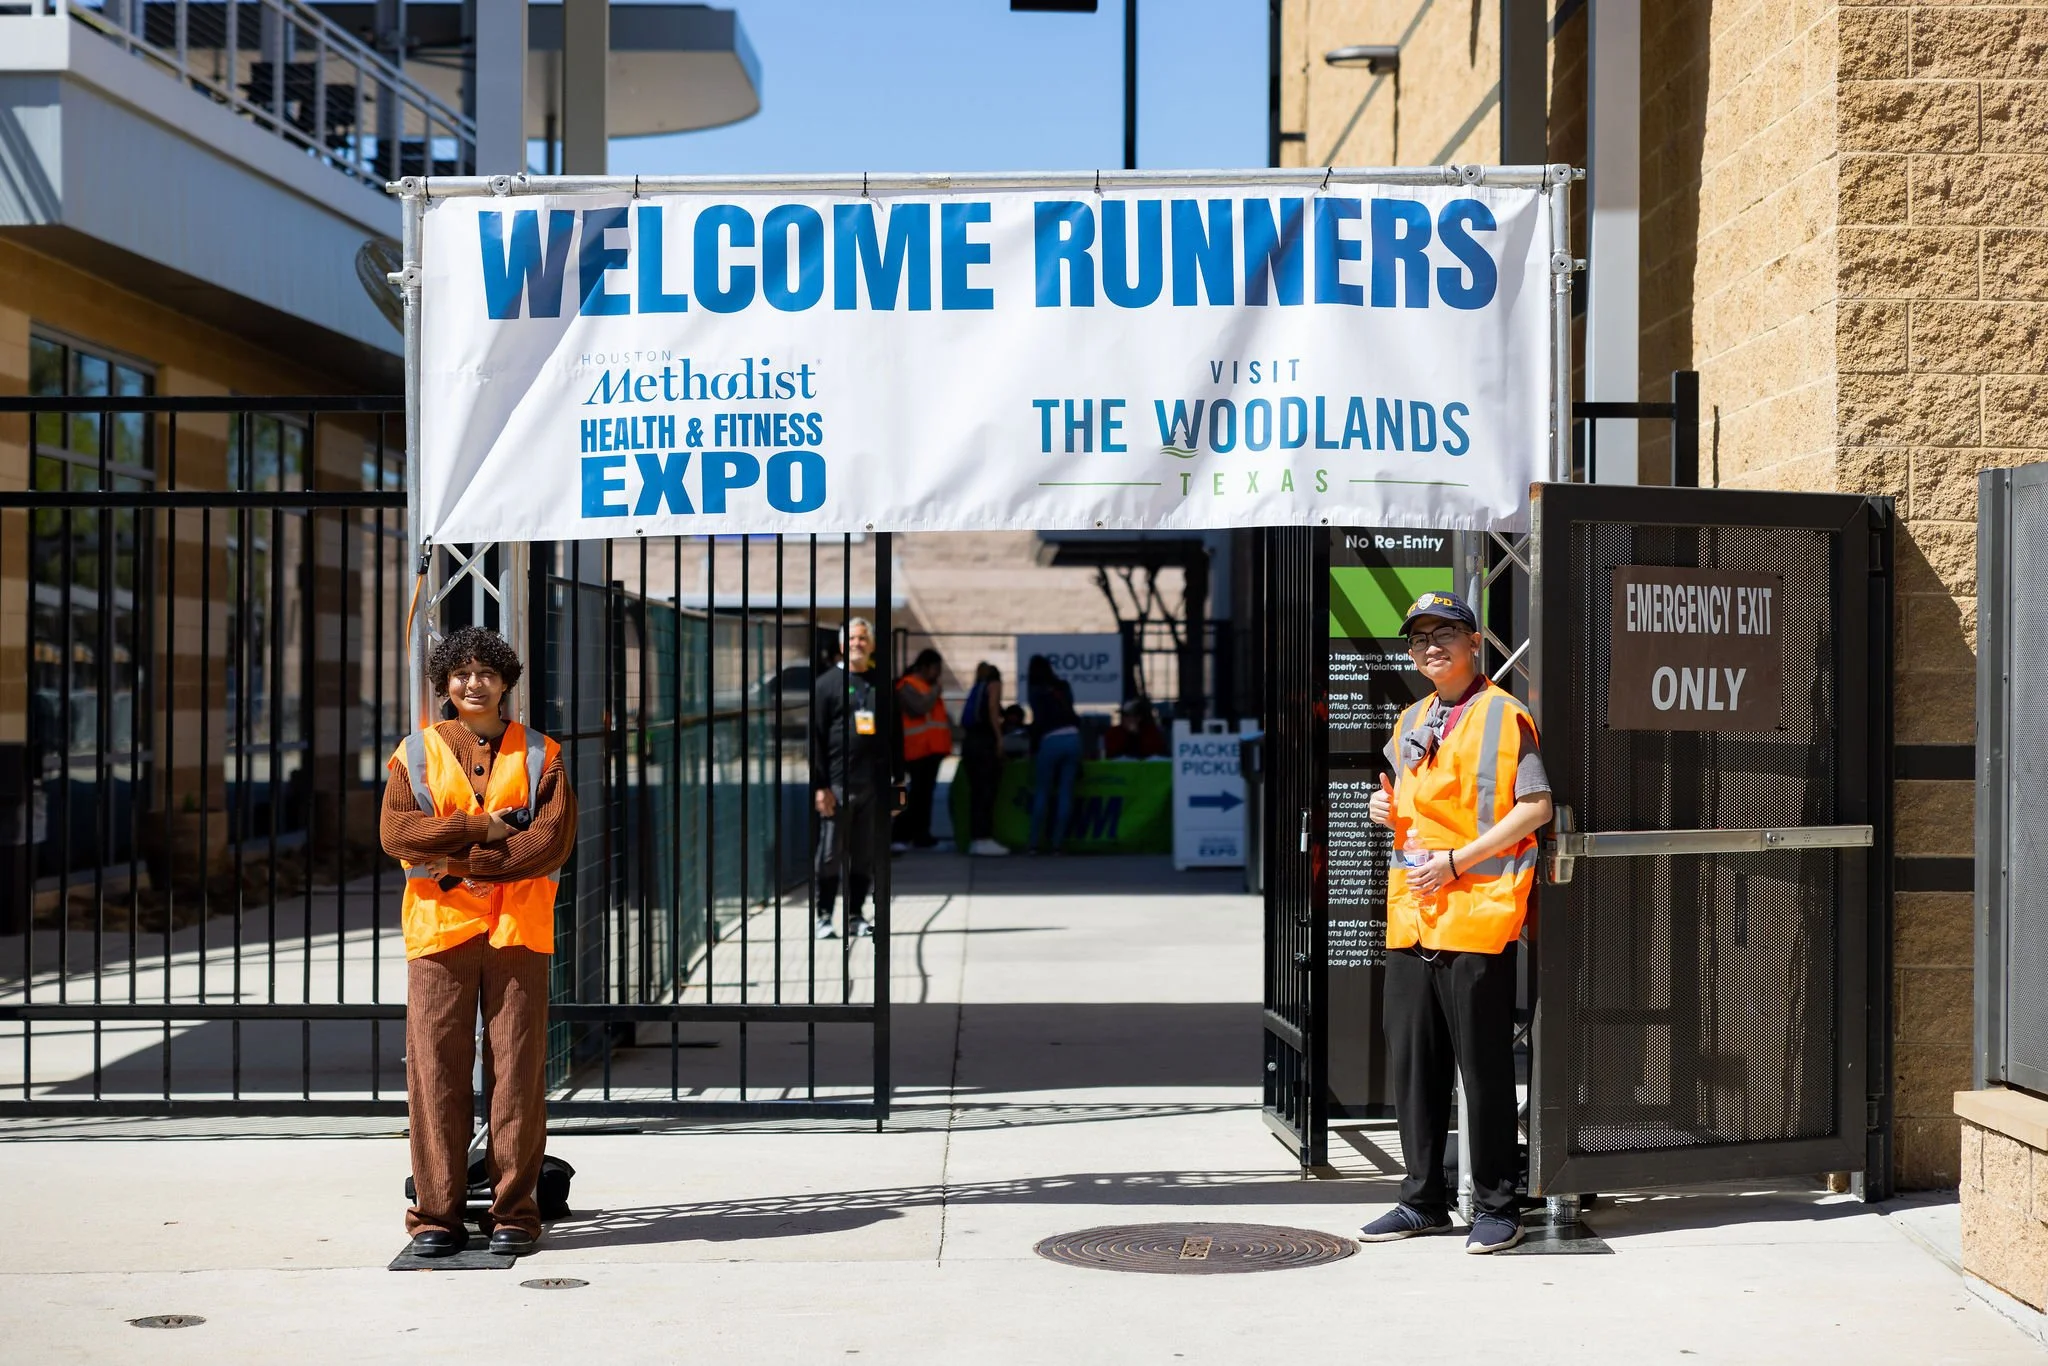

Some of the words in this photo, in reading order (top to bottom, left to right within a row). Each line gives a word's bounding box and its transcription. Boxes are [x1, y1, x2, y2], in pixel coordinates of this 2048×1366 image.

[479, 202, 994, 320] WELCOME
[1035, 197, 1497, 310] RUNNERS
[581, 350, 671, 366] HOUSTON
[1210, 358, 1301, 385] VISIT
[581, 414, 676, 452] HEALTH
[686, 416, 705, 448] &
[714, 412, 824, 447] FITNESS
[1033, 398, 1128, 453] THE
[1154, 395, 1471, 457] WOODLANDS
[581, 450, 827, 519] EXPO
[1179, 468, 1329, 497] TEXAS
[1346, 534, 1369, 549] No
[1374, 534, 1444, 551] Re-Entry
[1626, 583, 1732, 634] EMERGENCY
[1737, 586, 1772, 635] EXIT
[1046, 652, 1109, 671] ROUP
[1335, 653, 1382, 662] trespassing
[1395, 653, 1413, 661] loite
[1329, 663, 1357, 671] operty
[1365, 663, 1402, 671] Violators
[1329, 673, 1372, 681] osecuted.
[1651, 665, 1747, 711] ONLY
[1350, 692, 1363, 700] No
[1179, 743, 1241, 758] PACKE
[1182, 761, 1241, 776] PICKU
[1357, 849, 1379, 857] other
[1341, 878, 1366, 886] failure
[1361, 897, 1369, 905] to
[1338, 920, 1368, 928] and/or
[1344, 929, 1358, 937] left
[1349, 959, 1361, 968] go
